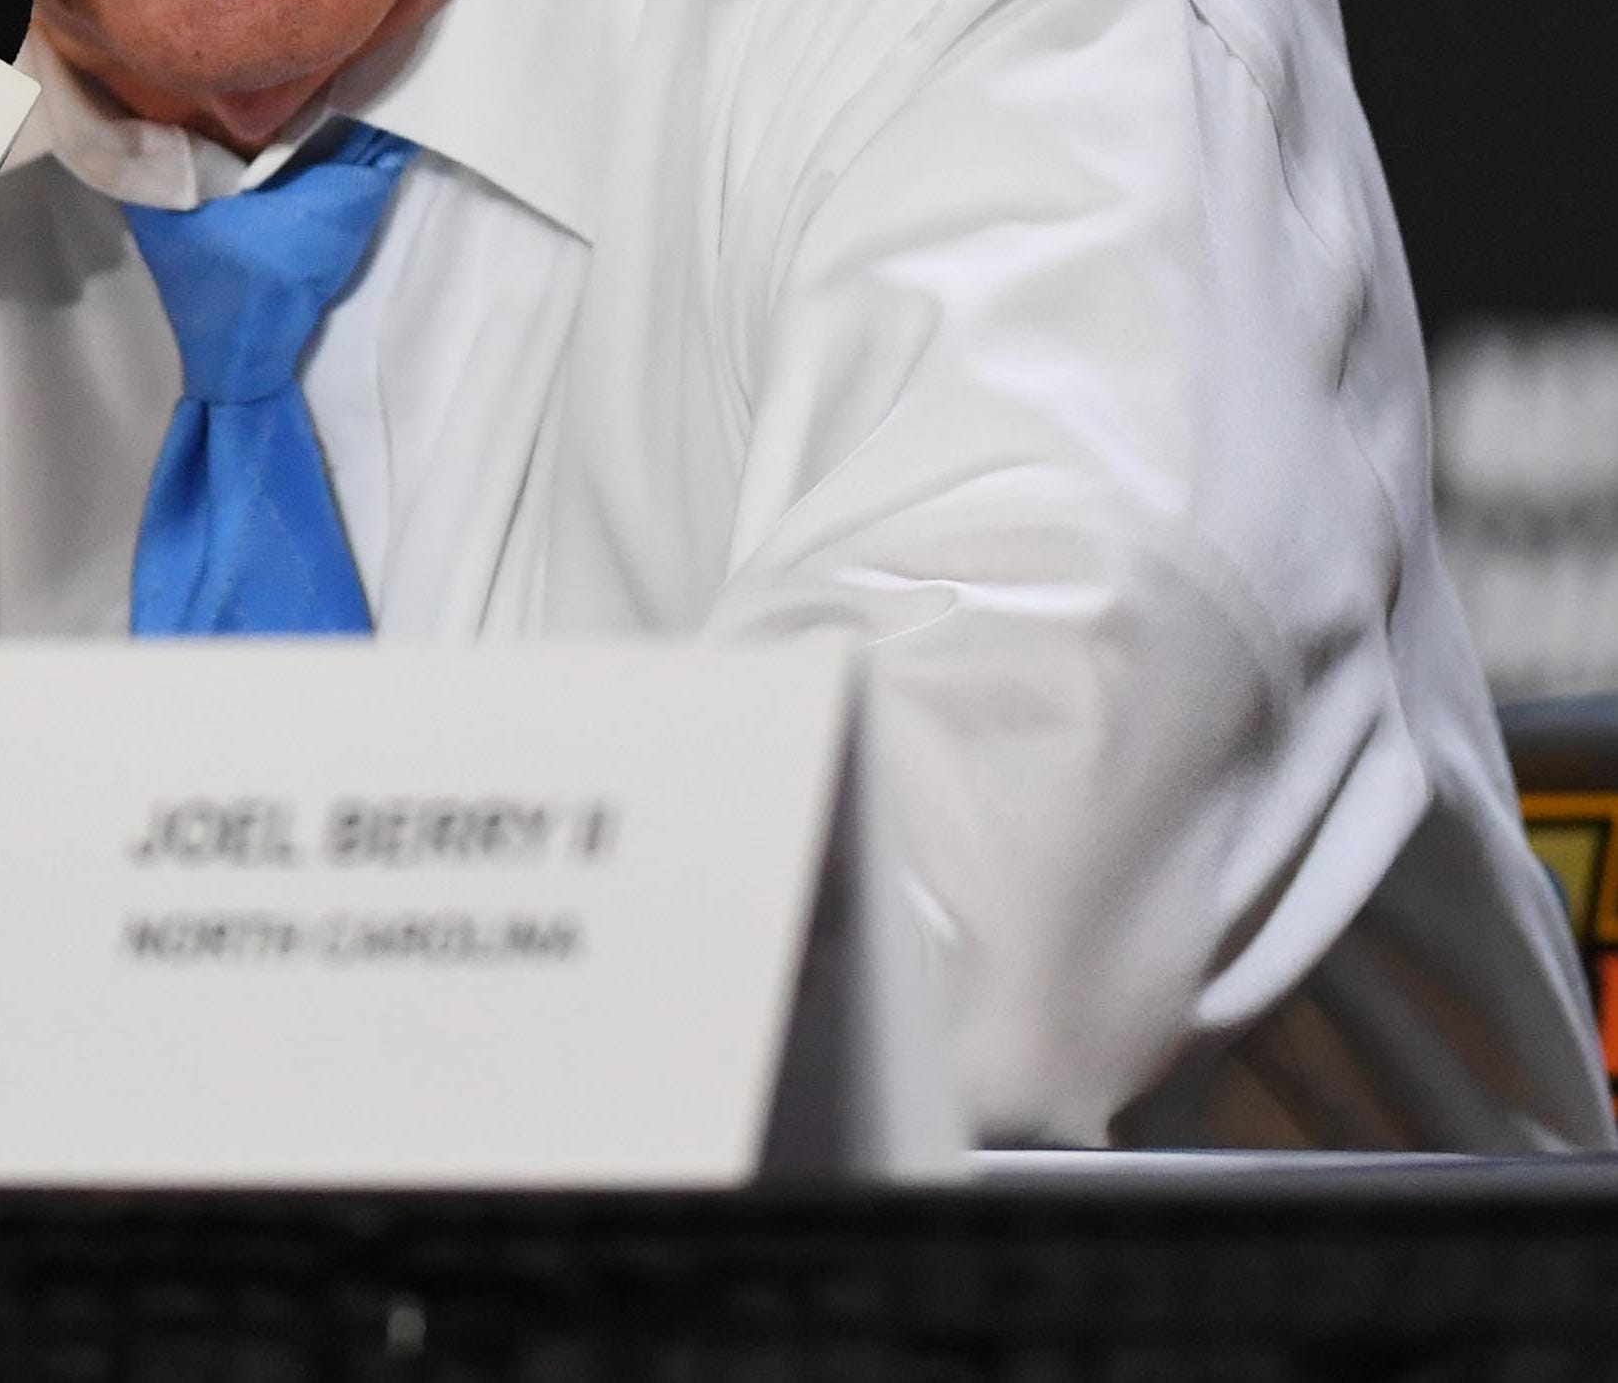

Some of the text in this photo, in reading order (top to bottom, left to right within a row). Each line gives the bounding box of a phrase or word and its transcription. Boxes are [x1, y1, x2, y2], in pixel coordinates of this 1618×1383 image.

[128, 798, 298, 869] JOEL
[321, 798, 553, 869] BERRY
[122, 913, 584, 967] NORTH CAROLINA
